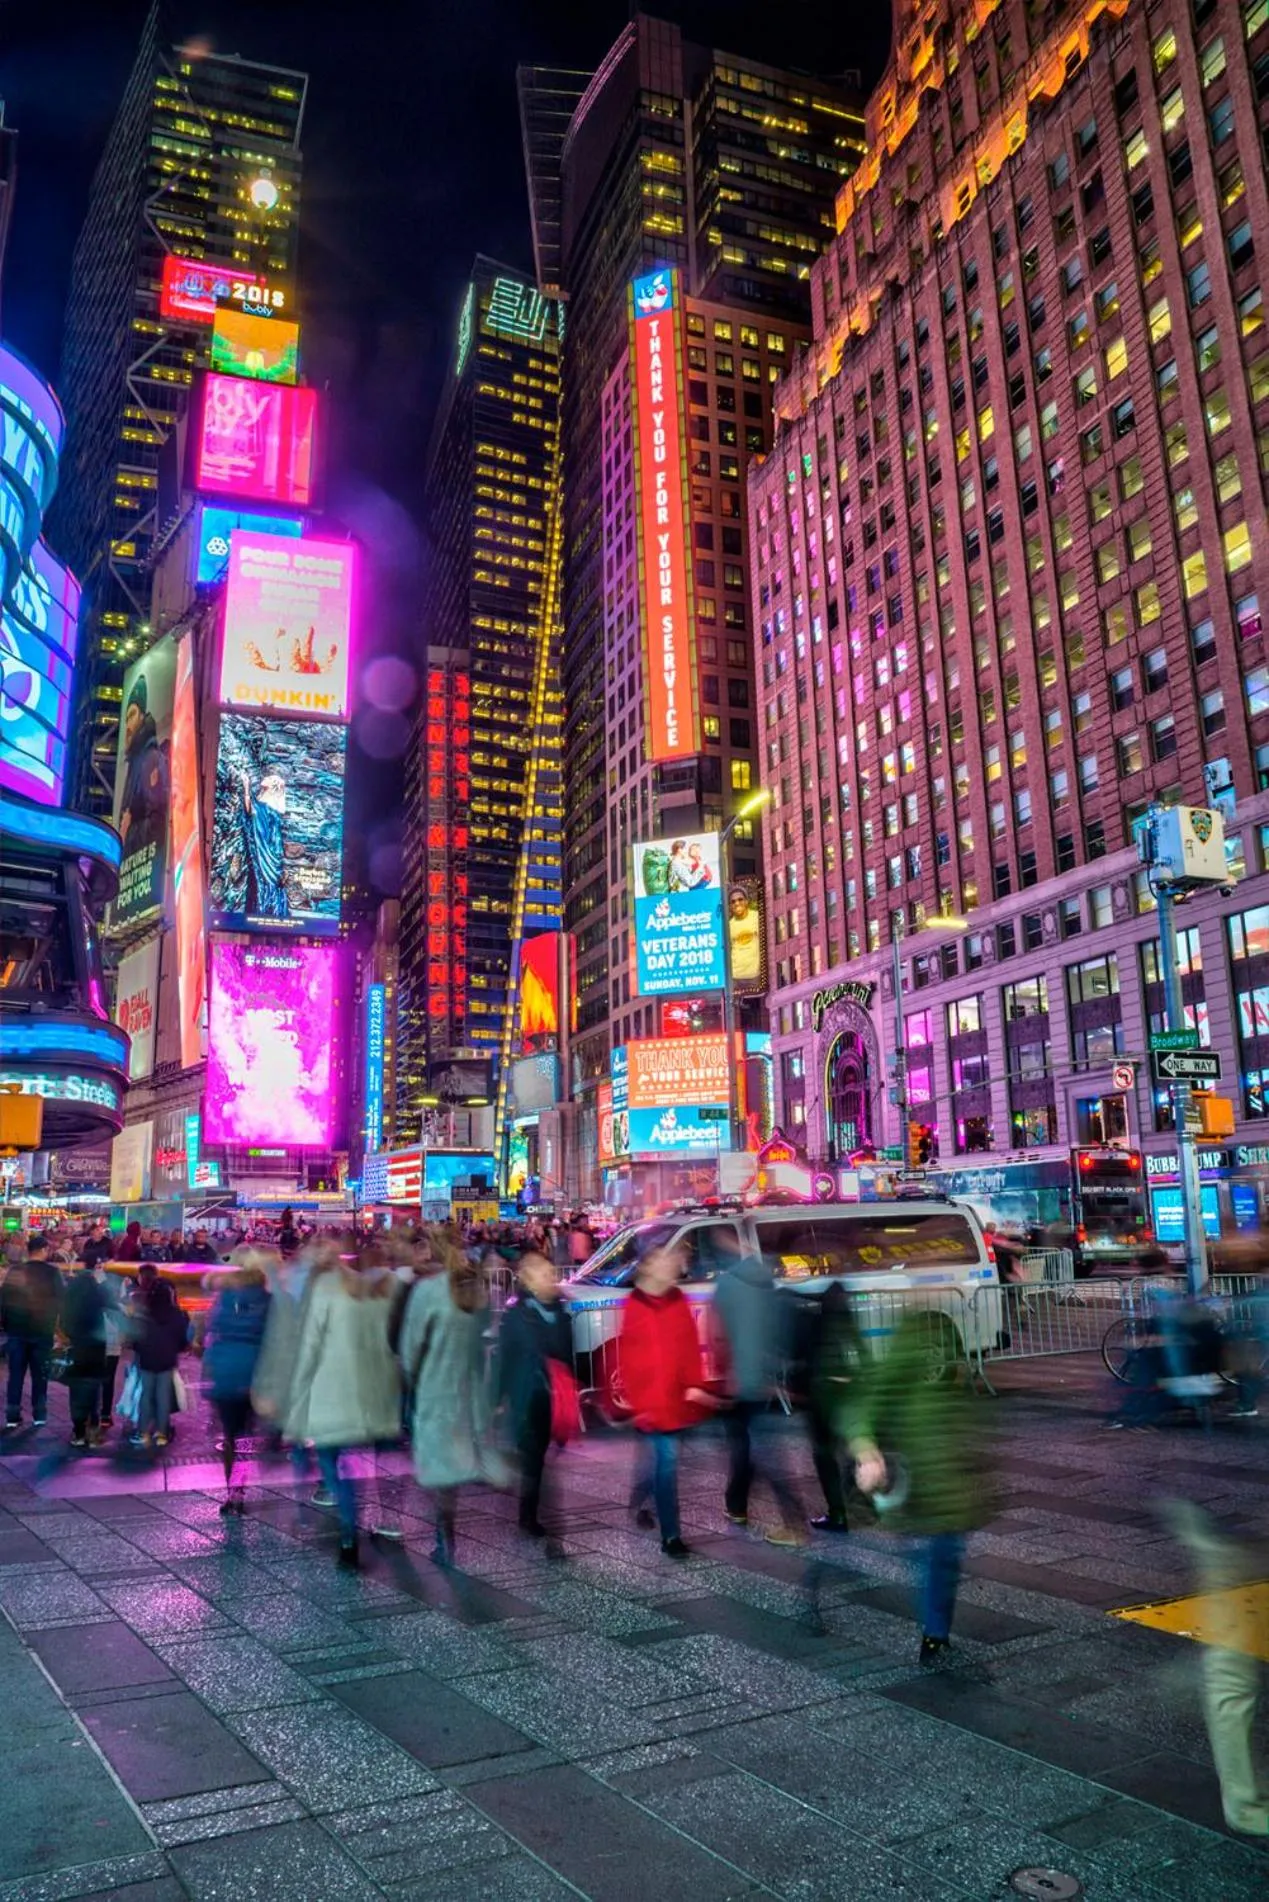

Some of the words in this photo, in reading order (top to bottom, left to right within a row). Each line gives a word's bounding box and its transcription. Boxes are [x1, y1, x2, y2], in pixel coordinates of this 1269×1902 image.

[232, 282, 285, 308] 2018
[649, 319, 664, 403] THANK
[651, 410, 667, 463] YOU
[655, 472, 670, 524] FOR
[657, 532, 672, 605] YOUR
[661, 615, 679, 747] SERVICE
[641, 933, 718, 955] VETERANS
[647, 953, 676, 971] DAY
[679, 949, 714, 967] 2018
[1150, 1034, 1197, 1049] Broadway
[635, 1049, 694, 1073] THANK
[1166, 1061, 1186, 1071] ONE
[1193, 1060, 1213, 1071] WAY
[1145, 1155, 1181, 1174] BUBB
